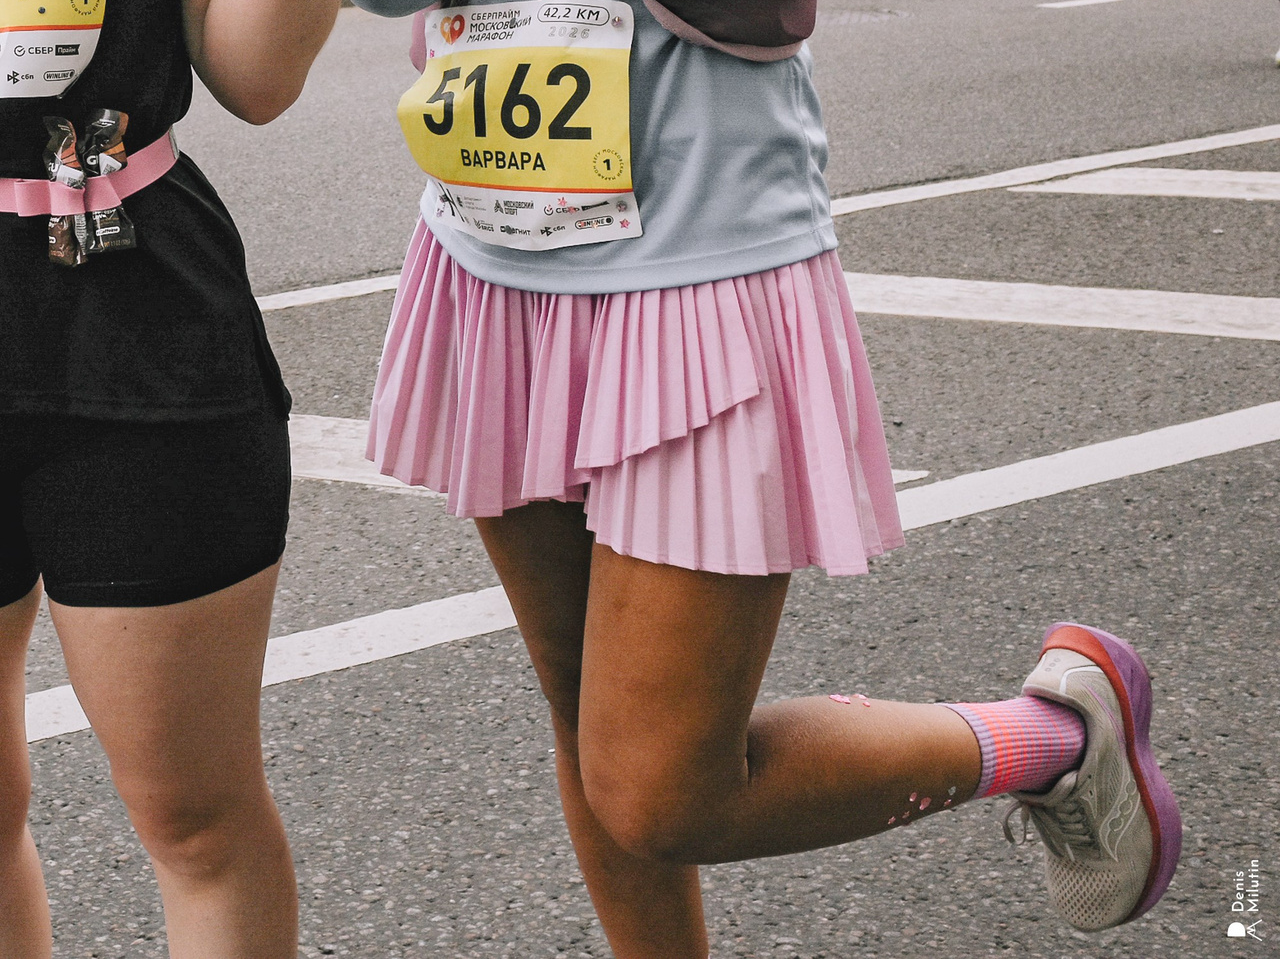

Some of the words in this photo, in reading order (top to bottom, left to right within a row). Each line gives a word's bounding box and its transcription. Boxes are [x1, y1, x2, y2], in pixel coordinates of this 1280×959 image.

[471, 8, 521, 21] СБЕРПРАЙМ
[543, 7, 572, 20] 42,2
[469, 16, 532, 33] МОСКОВКИЙ
[467, 30, 515, 43] МАРАФОН
[548, 26, 591, 39] 2026
[28, 46, 54, 55] СБЕР
[422, 62, 592, 140] 5162
[460, 148, 546, 171] ВАРВАРА
[603, 158, 611, 171] 1
